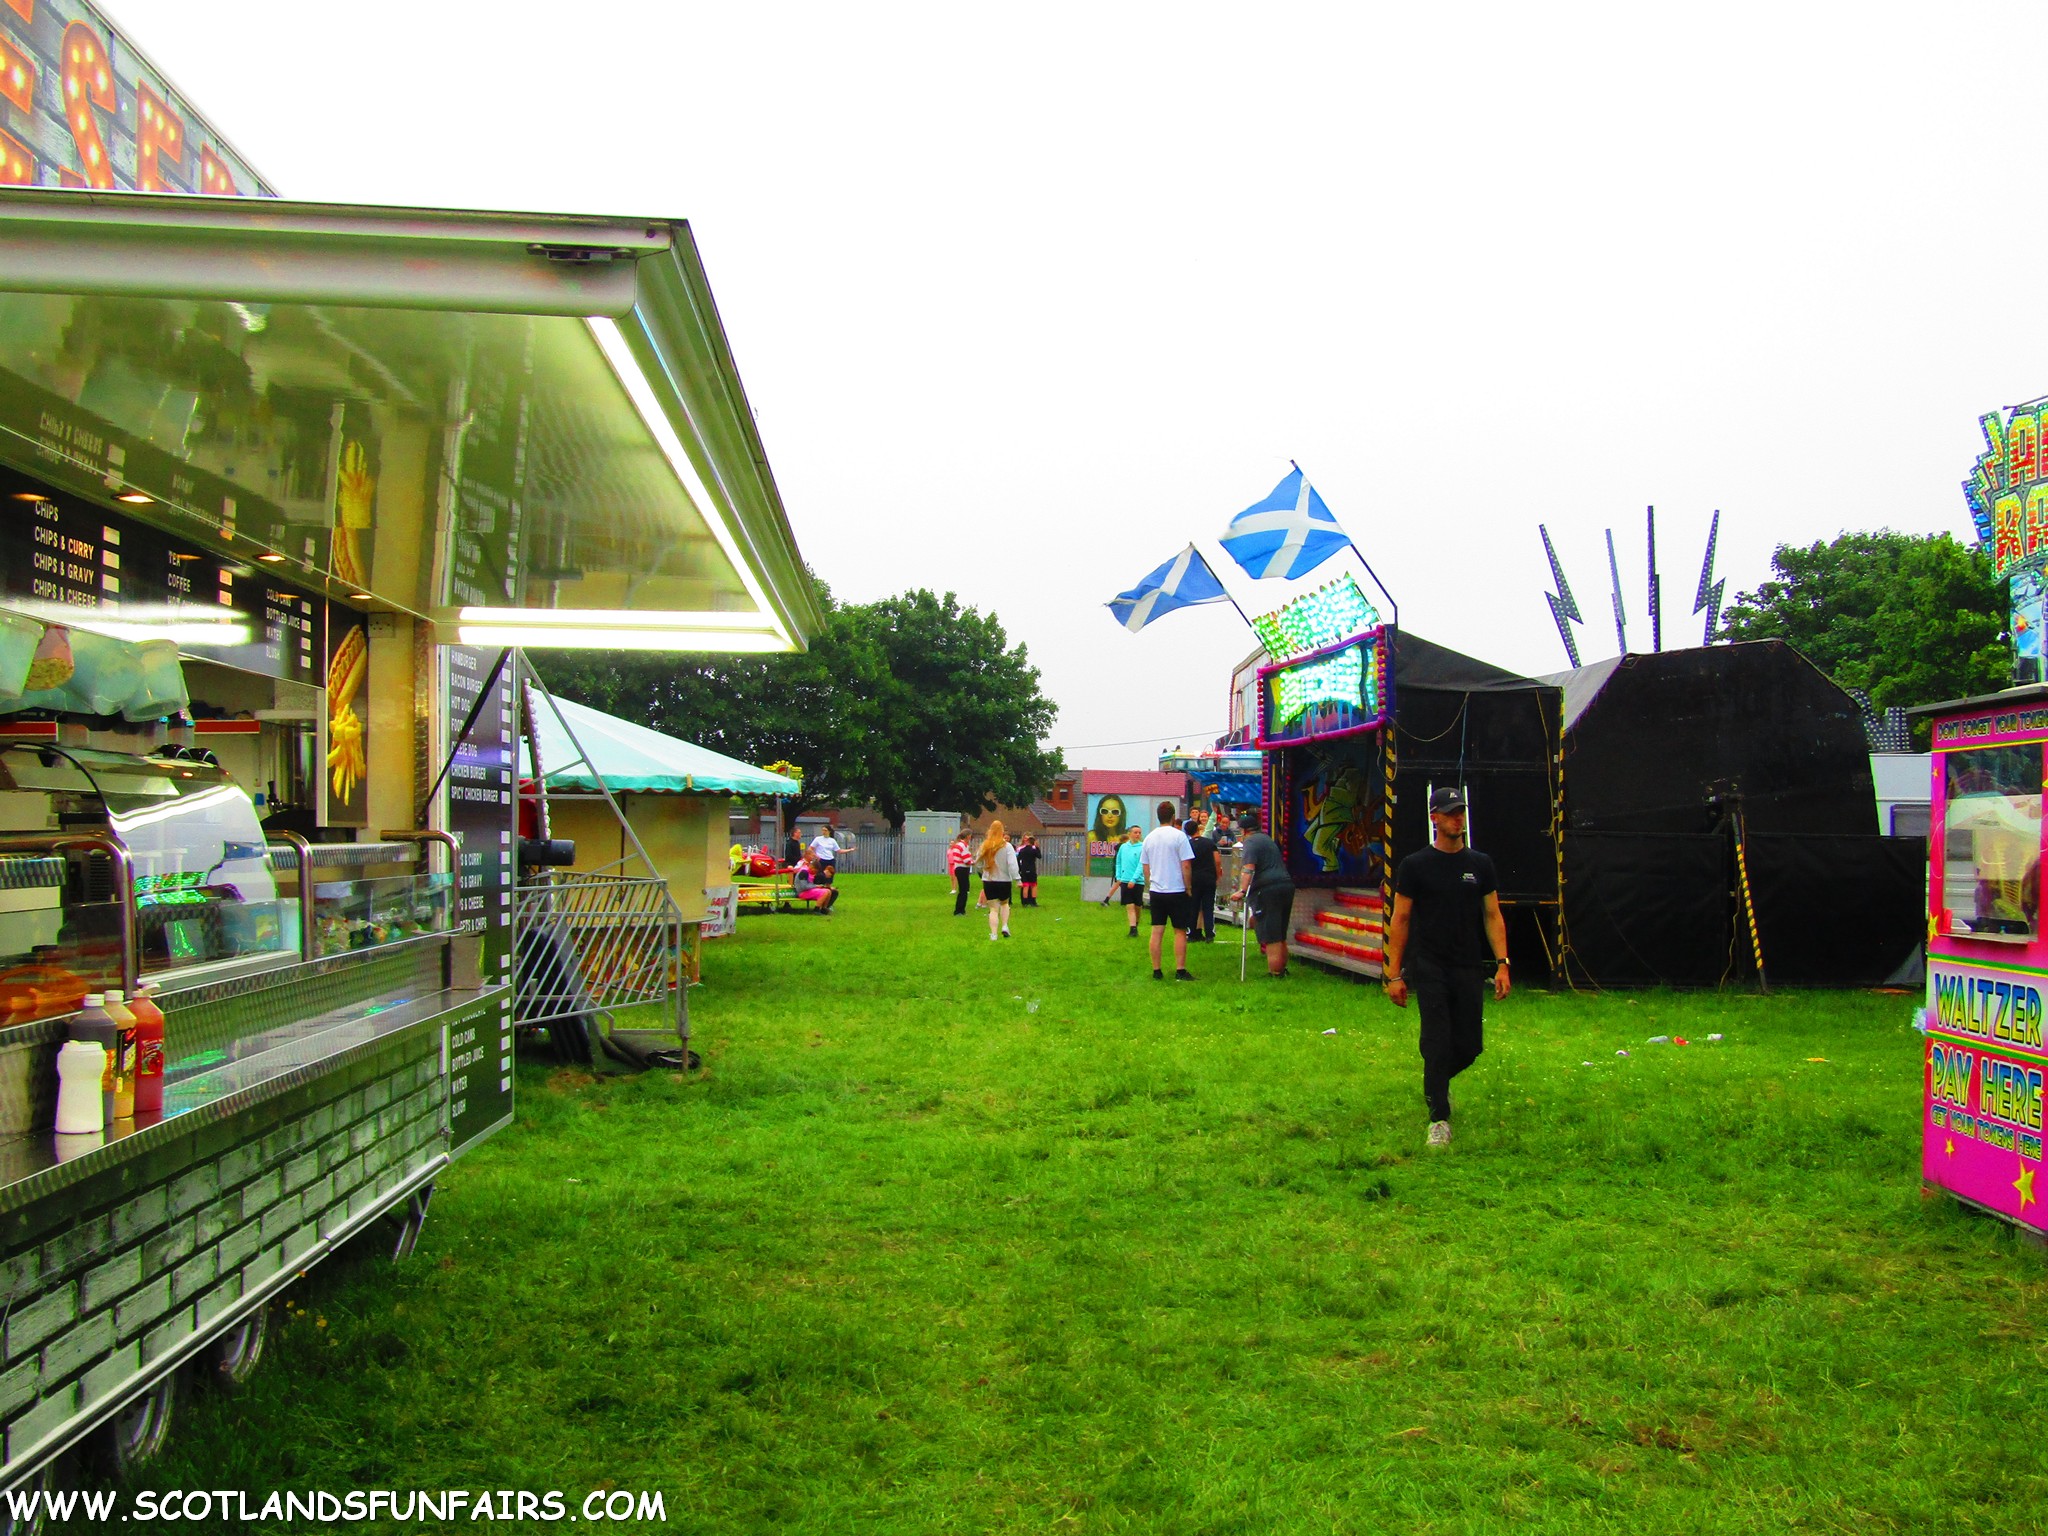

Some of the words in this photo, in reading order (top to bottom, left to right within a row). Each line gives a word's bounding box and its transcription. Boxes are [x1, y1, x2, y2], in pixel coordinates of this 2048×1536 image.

[34, 501, 59, 522] CHIPS
[34, 525, 58, 548] CHIPS
[61, 535, 66, 550] &
[68, 538, 94, 560] CURRY
[33, 552, 58, 574] CHIPS
[60, 561, 65, 576] &
[67, 563, 94, 585] GRAVY
[168, 550, 181, 567] TEA
[167, 573, 191, 593] COFFEE
[33, 578, 57, 600] CHIPS
[60, 587, 65, 602] &
[67, 589, 97, 609] CHEESE
[266, 588, 279, 603] COLD
[266, 606, 288, 625] BOTTLED
[288, 614, 301, 629] JUICE
[266, 625, 283, 642] WATER
[1960, 716, 1992, 739] FORGET
[1994, 712, 2018, 735] YOUR
[451, 763, 470, 778] CHICKEN
[470, 765, 487, 780] BURGER
[451, 785, 465, 800] SPICY
[465, 787, 483, 802] CHICKEN
[482, 788, 499, 803] BURGER
[468, 852, 483, 866] CURRY
[468, 874, 483, 888] GRAVY
[468, 895, 484, 910] CHEESE
[1934, 972, 2043, 1050] WALTZER
[452, 1032, 464, 1049] COLD
[452, 1051, 472, 1072] BOTTLED
[452, 1075, 468, 1095] WATER
[1931, 1044, 1973, 1107] PAY
[1980, 1057, 2043, 1132] HERE
[452, 1098, 466, 1118] SLUSH
[1931, 1104, 1948, 1129] GET
[1949, 1107, 1976, 1139] YOUR
[1976, 1118, 2015, 1153] TOKENS
[2017, 1130, 2043, 1162] HERE
